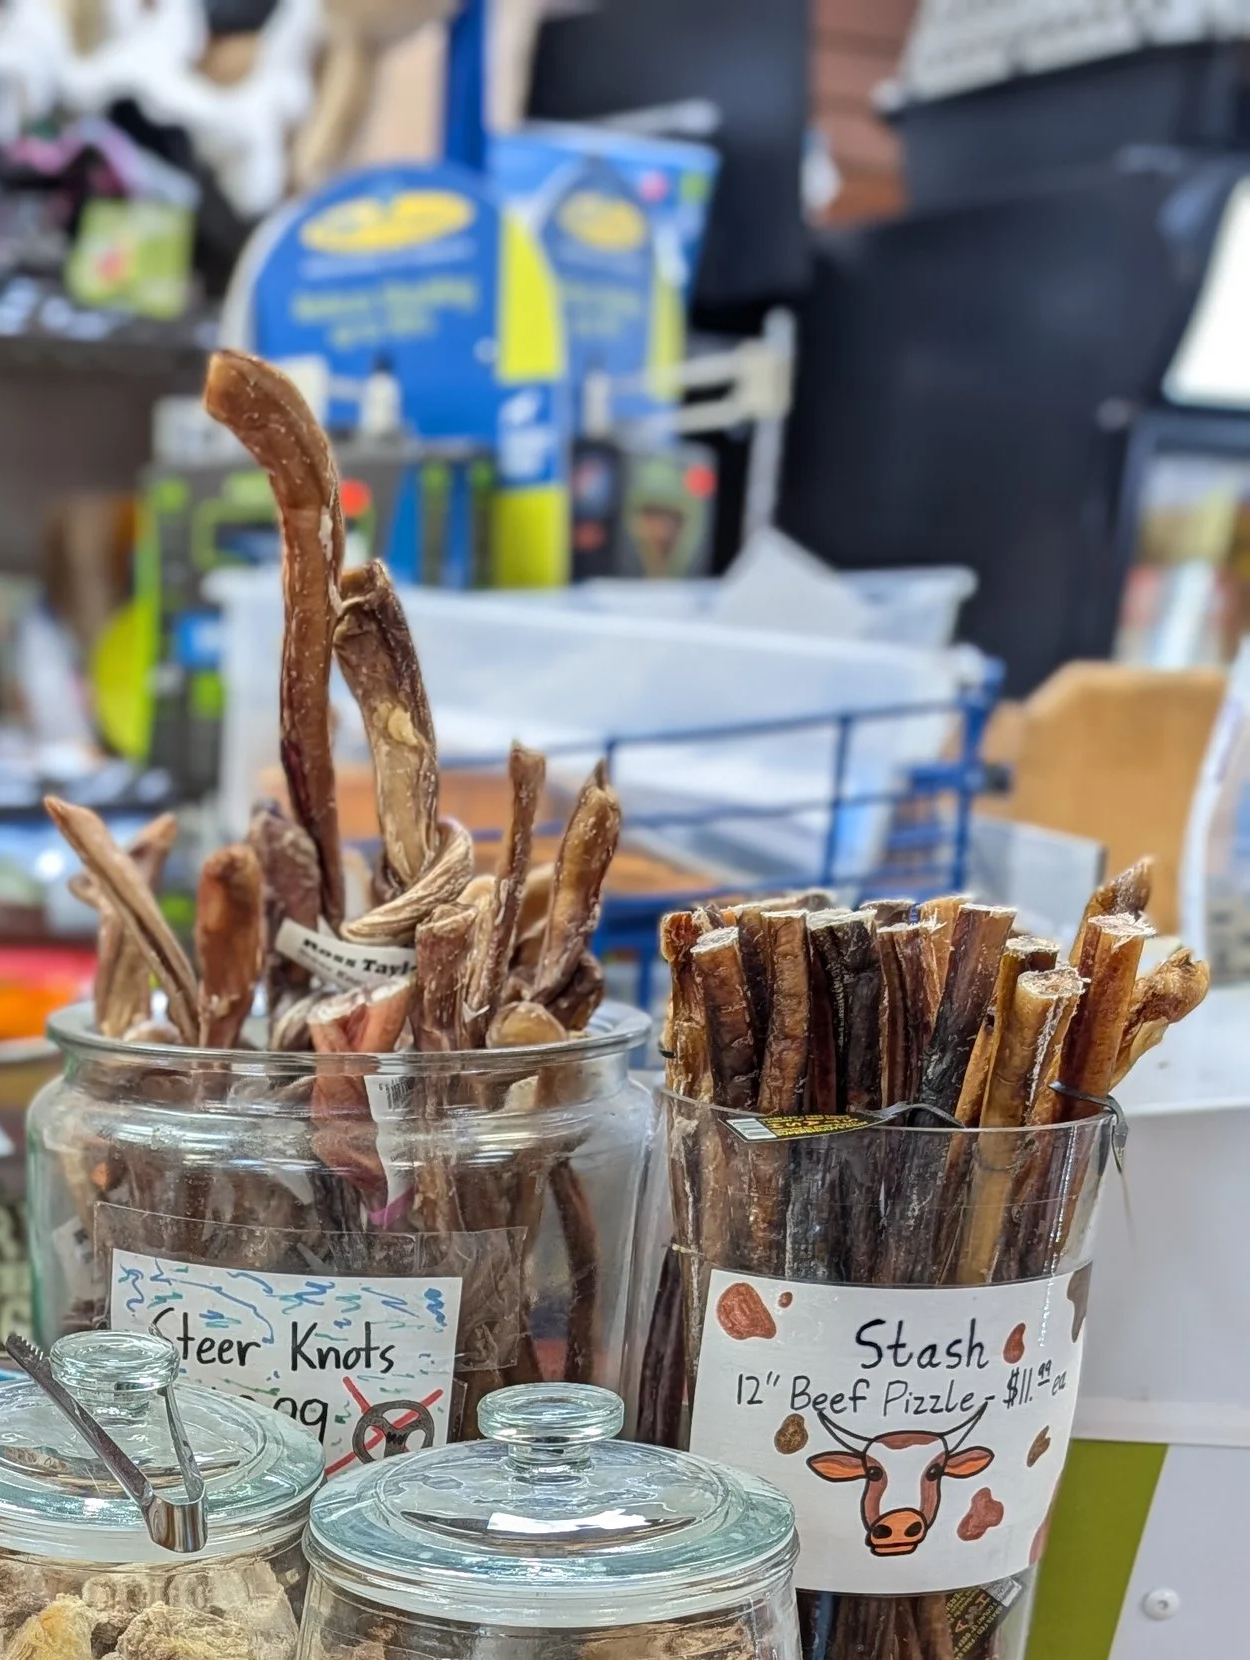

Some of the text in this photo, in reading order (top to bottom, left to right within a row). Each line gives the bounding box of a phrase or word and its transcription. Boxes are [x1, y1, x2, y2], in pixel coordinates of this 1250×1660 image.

[290, 1321, 396, 1373] Knots
[855, 1318, 990, 1370] Stash
[736, 1375, 780, 1405] 12"
[790, 1376, 870, 1415] Beef
[883, 1380, 974, 1417] Pizzle
